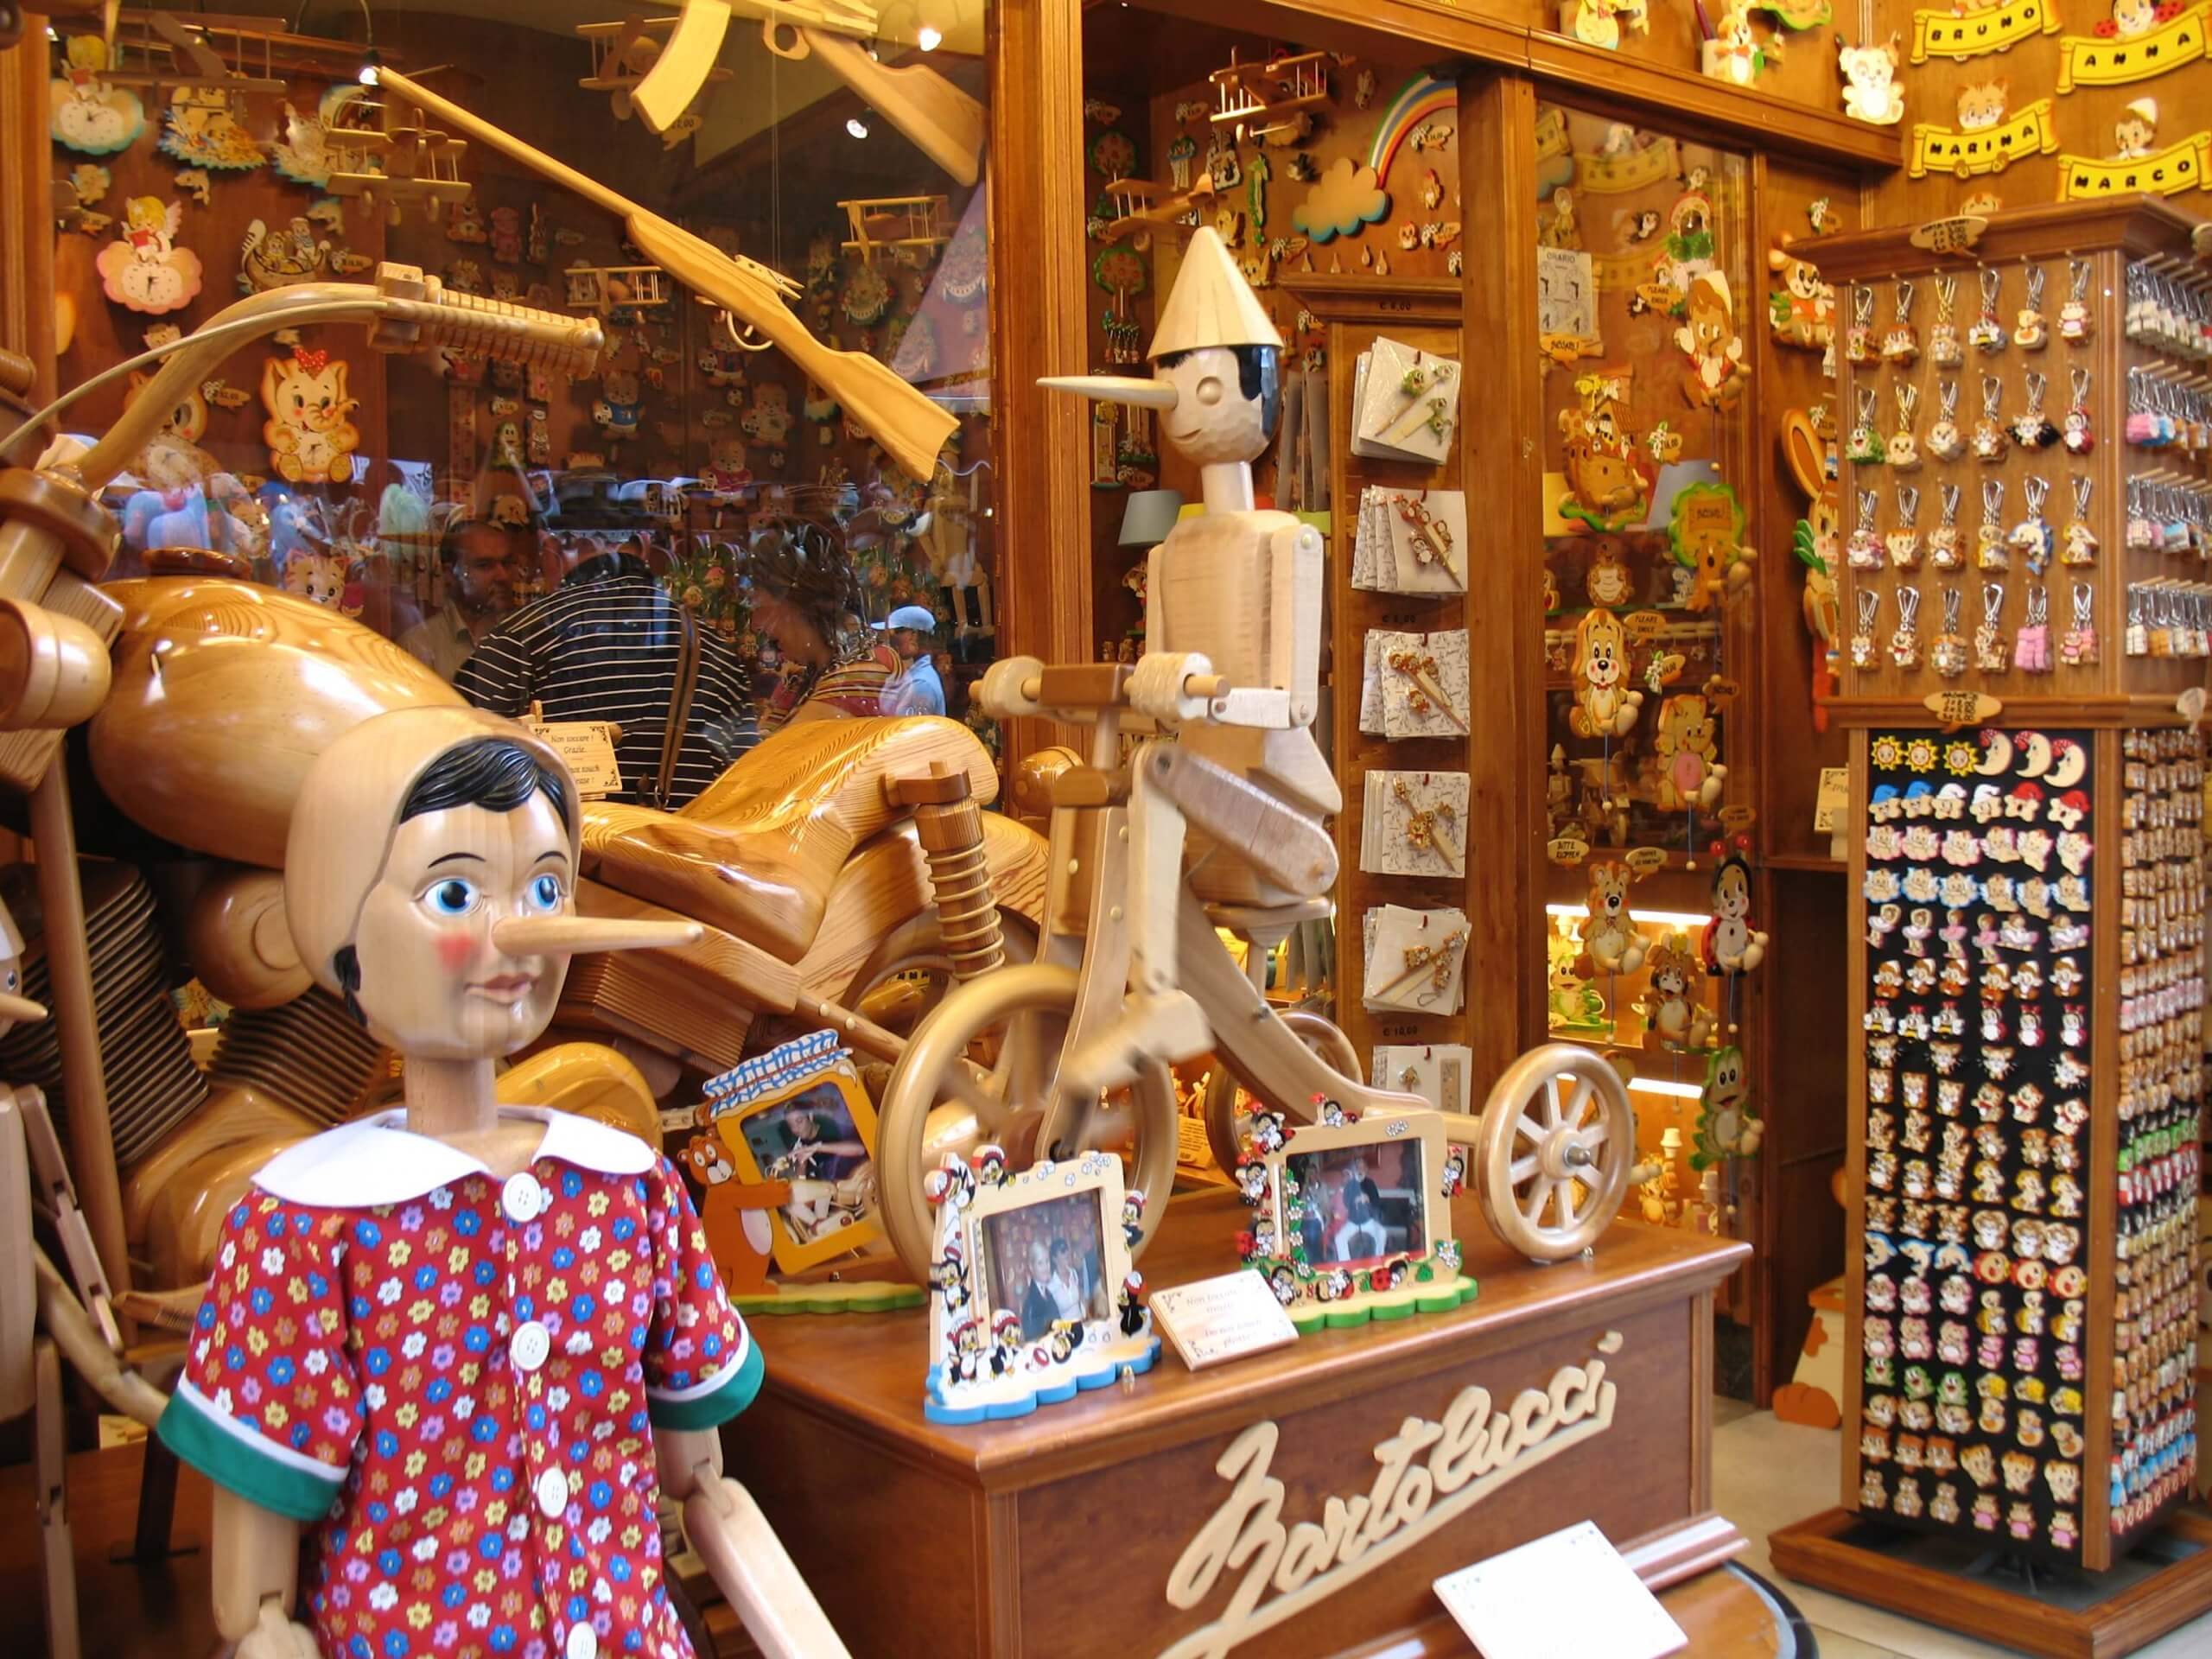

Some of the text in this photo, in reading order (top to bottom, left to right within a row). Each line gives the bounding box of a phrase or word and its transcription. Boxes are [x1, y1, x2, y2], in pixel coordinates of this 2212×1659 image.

[1931, 7, 2035, 41] BRUNO
[2084, 32, 2191, 67] ANNA
[1929, 124, 2034, 155] MARINA
[2074, 160, 2191, 189] MARCO
[1166, 1330, 1624, 1624] Bartolucci
